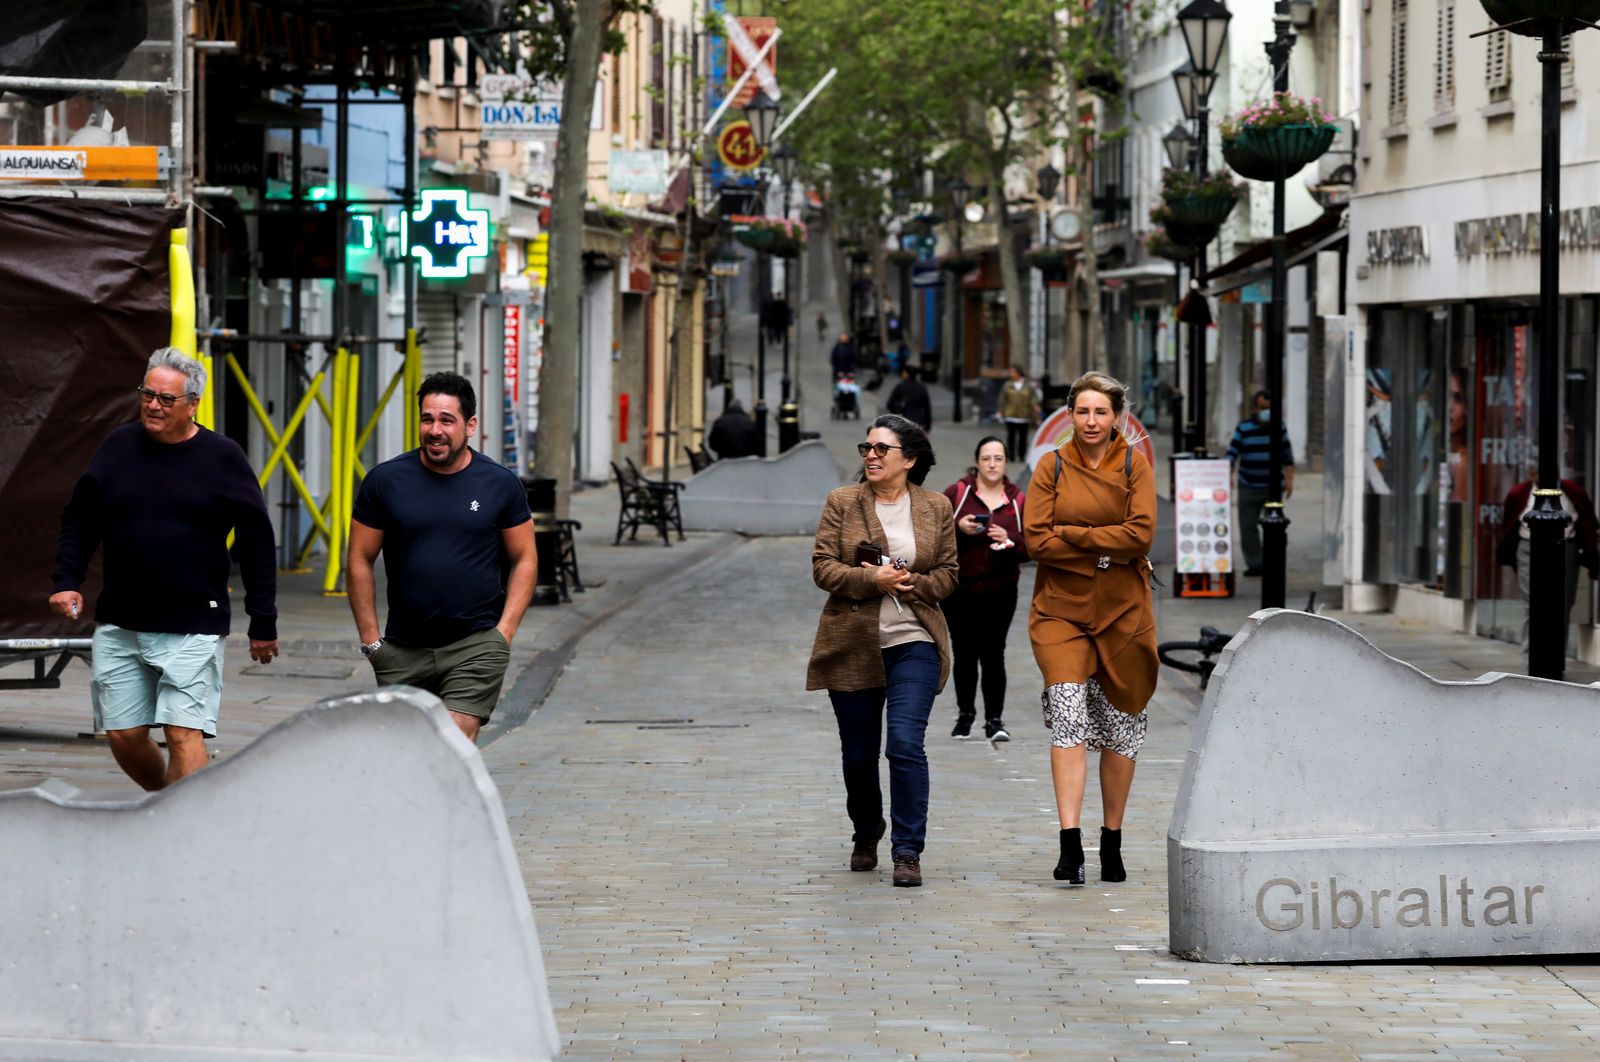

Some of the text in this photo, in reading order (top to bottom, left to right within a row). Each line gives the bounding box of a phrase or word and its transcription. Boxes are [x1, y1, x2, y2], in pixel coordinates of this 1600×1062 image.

[483, 105, 526, 124] DON
[726, 132, 757, 159] 41
[3, 156, 79, 170] ALQUIANSA
[1483, 376, 1532, 406] TAX
[1256, 874, 1545, 931] Gibraltar
